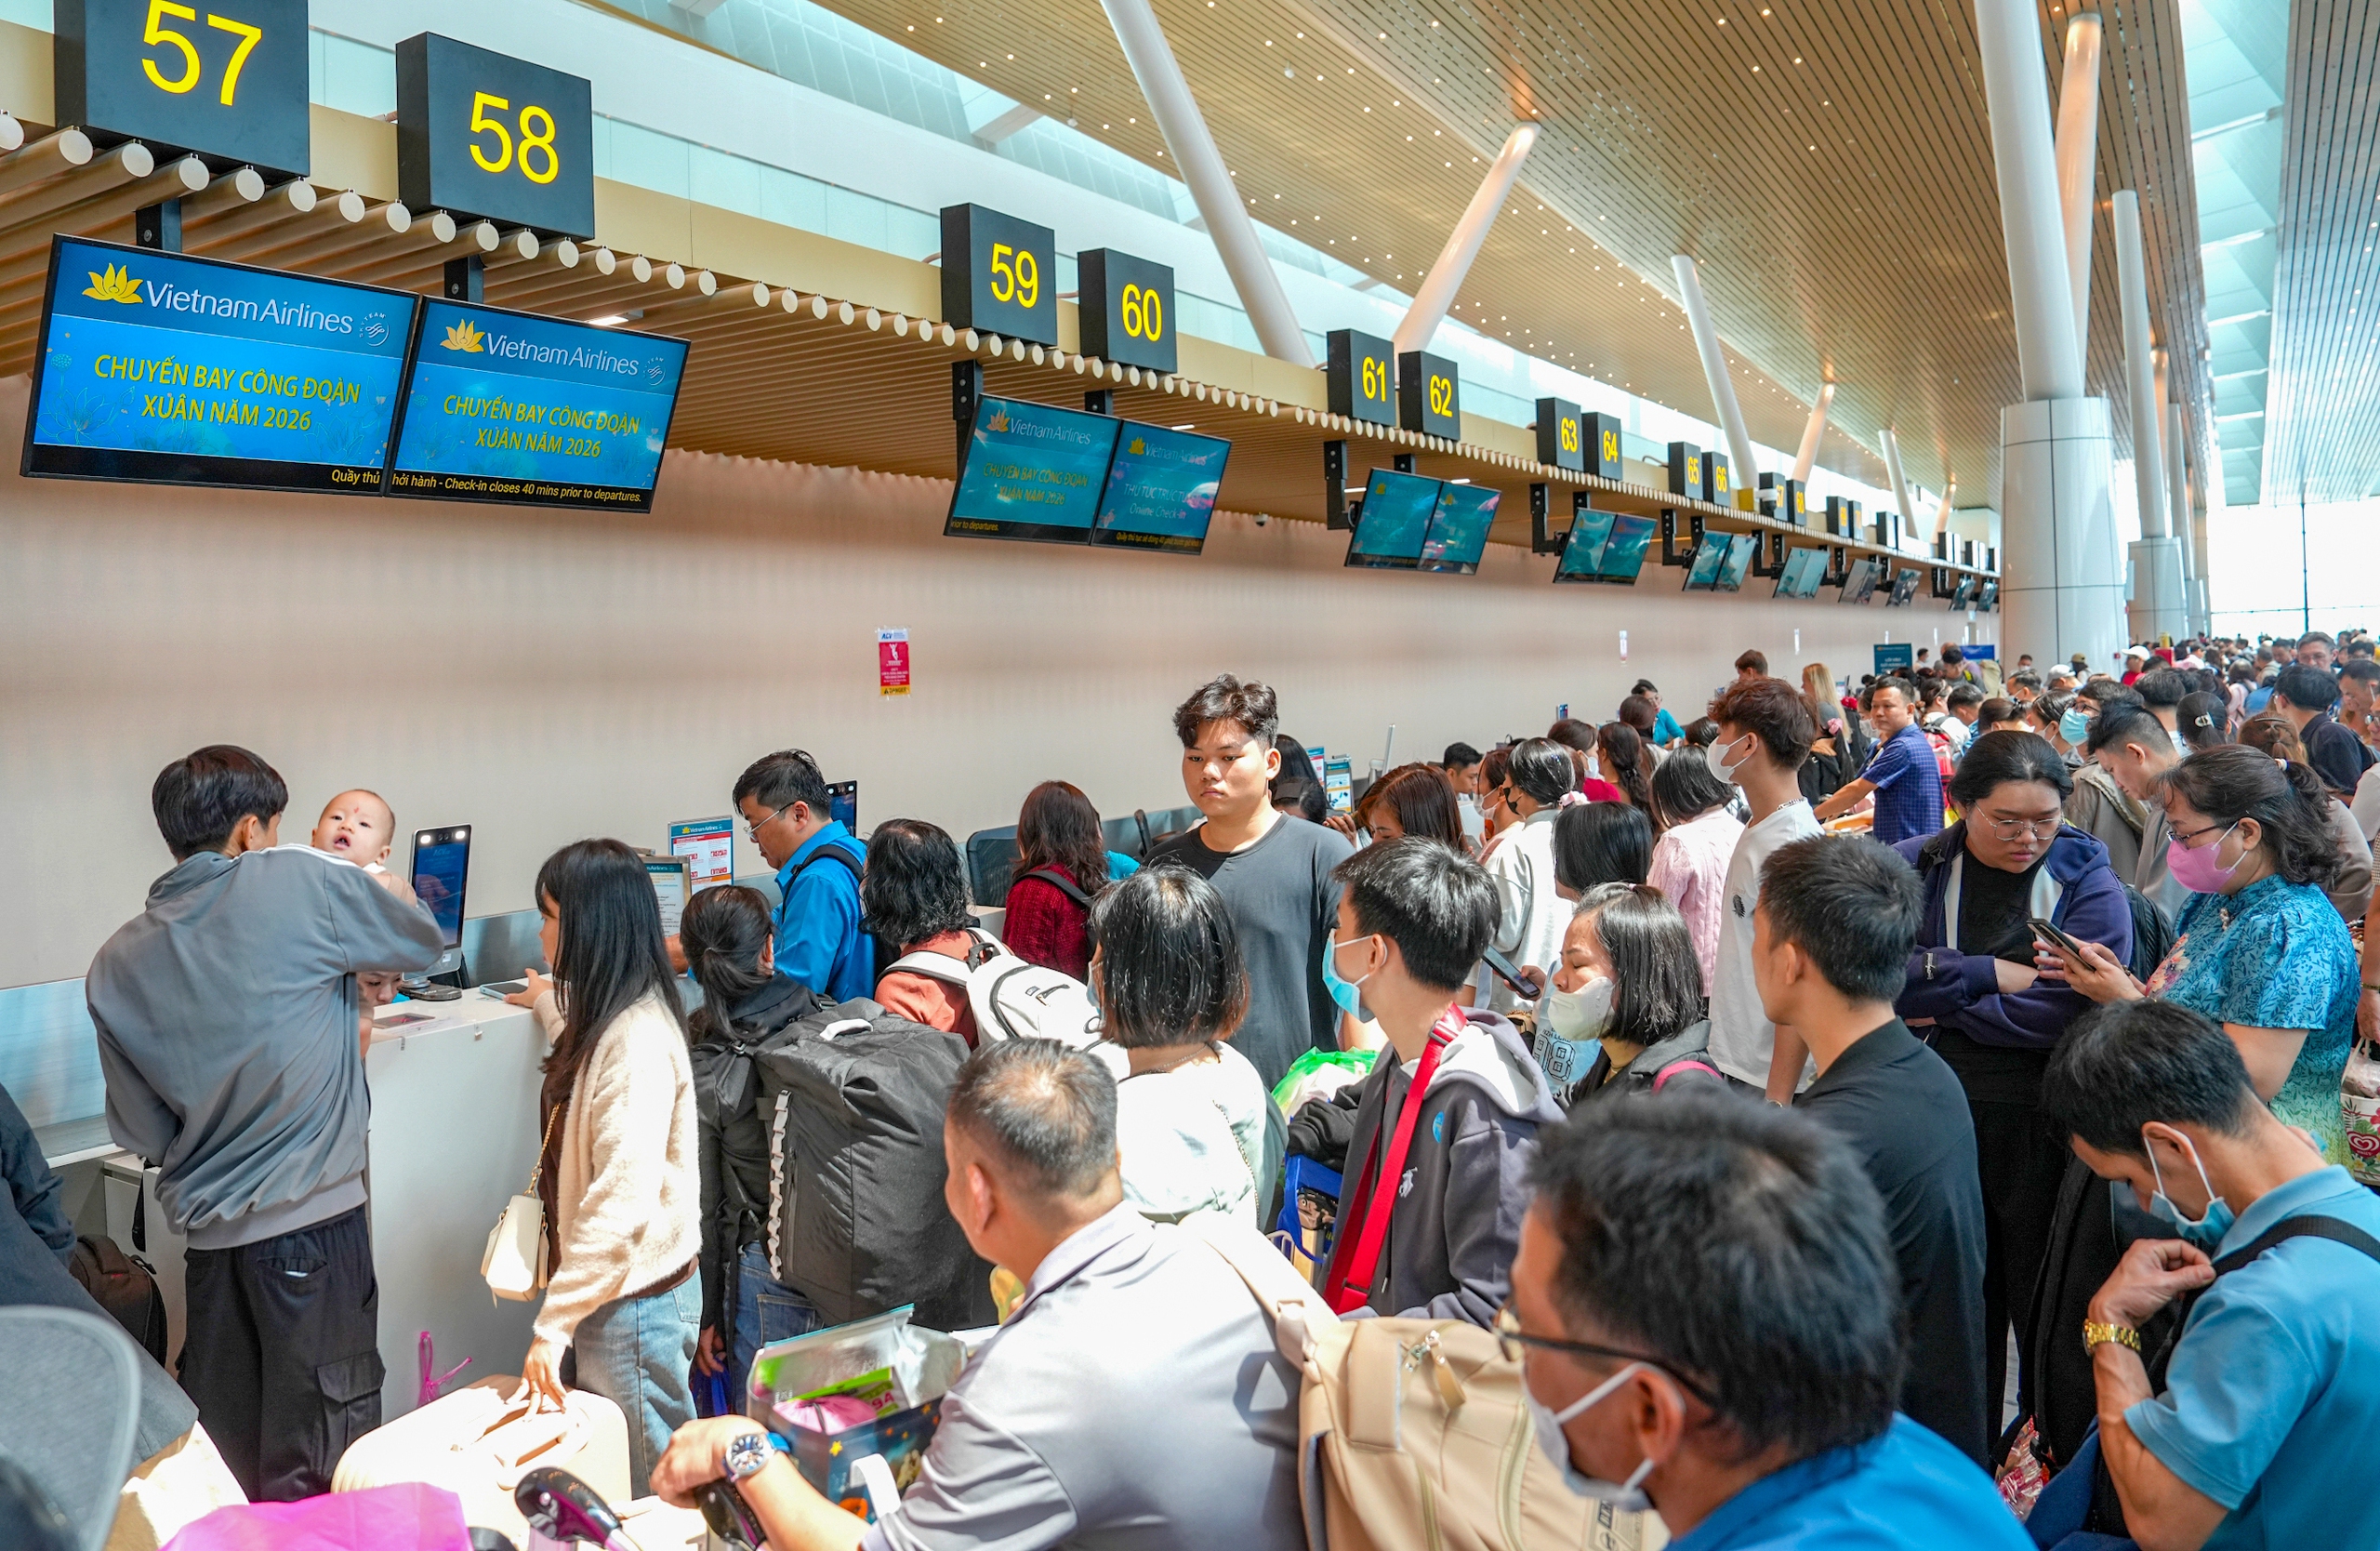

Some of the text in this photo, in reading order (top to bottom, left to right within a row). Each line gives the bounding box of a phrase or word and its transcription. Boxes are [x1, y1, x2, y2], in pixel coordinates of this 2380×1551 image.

[141, 0, 262, 107] 57
[469, 91, 560, 185] 58
[990, 243, 1038, 309] 59
[1121, 283, 1162, 342] 60
[94, 353, 361, 404] CHUYẾN BAY CÔNG ĐOÀN
[1362, 356, 1387, 402] 61
[1429, 374, 1453, 418] 62
[141, 393, 311, 431] XUÂN NĂM 2026
[443, 393, 514, 421] CHUYẾN
[516, 403, 548, 424] BAY
[549, 404, 594, 431] CÔNG
[476, 426, 602, 458] XUÂN NĂM 2026
[1561, 417, 1578, 453] 63
[1603, 430, 1619, 463] 64
[332, 468, 380, 486] Quầy thủ
[391, 471, 408, 485] hởi
[411, 473, 437, 488] hành
[445, 477, 487, 492] Check-in
[489, 481, 521, 494] closes
[522, 483, 535, 495] 40
[536, 484, 559, 497] mins
[560, 486, 581, 500] prior
[583, 487, 593, 498] to
[594, 489, 641, 503] departures.
[1021, 467, 1038, 481] BAY
[1687, 456, 1699, 484] 65
[1716, 466, 1727, 493] 66
[1045, 490, 1066, 505] 2026
[951, 520, 962, 529] rior
